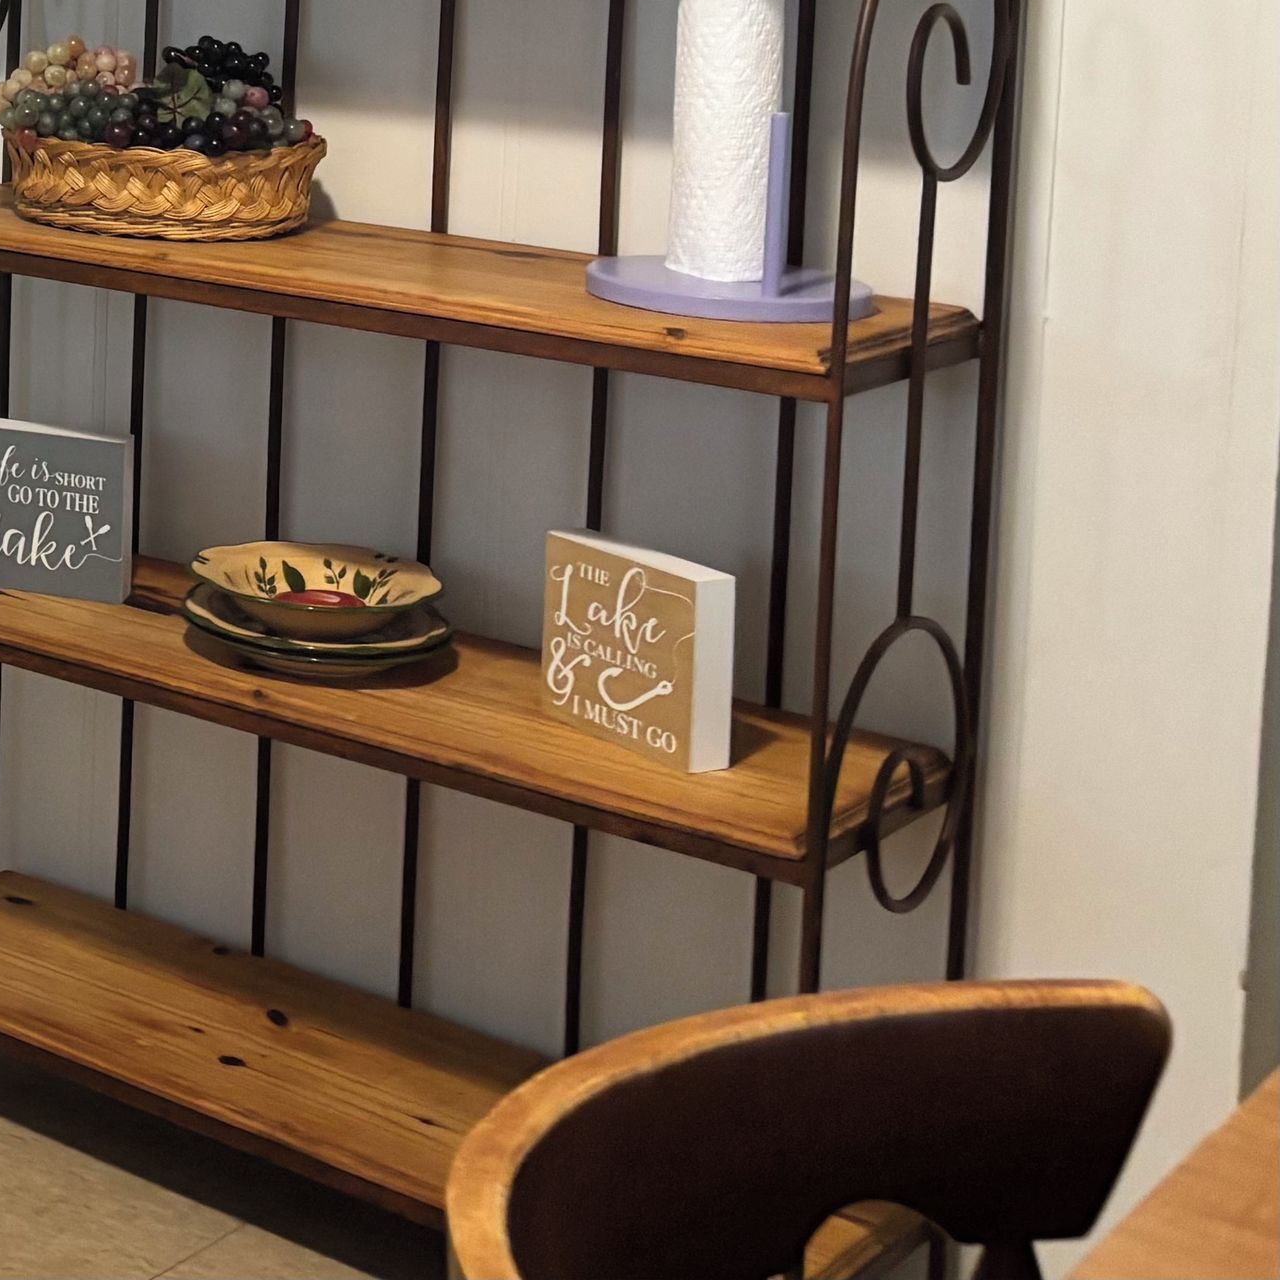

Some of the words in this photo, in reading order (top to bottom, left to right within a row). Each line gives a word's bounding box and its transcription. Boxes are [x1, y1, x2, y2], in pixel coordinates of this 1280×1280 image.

[31, 458, 52, 482] is
[55, 472, 106, 491] SHORT
[7, 485, 32, 505] GO
[35, 488, 59, 509] TO
[63, 491, 100, 514] THE
[577, 562, 610, 587] THE
[550, 564, 666, 654] Lake
[547, 637, 591, 706] &
[567, 632, 581, 649] IS
[583, 638, 658, 679] CALLING
[573, 695, 579, 714] I
[583, 699, 642, 739] MUST
[646, 726, 677, 754] GO
